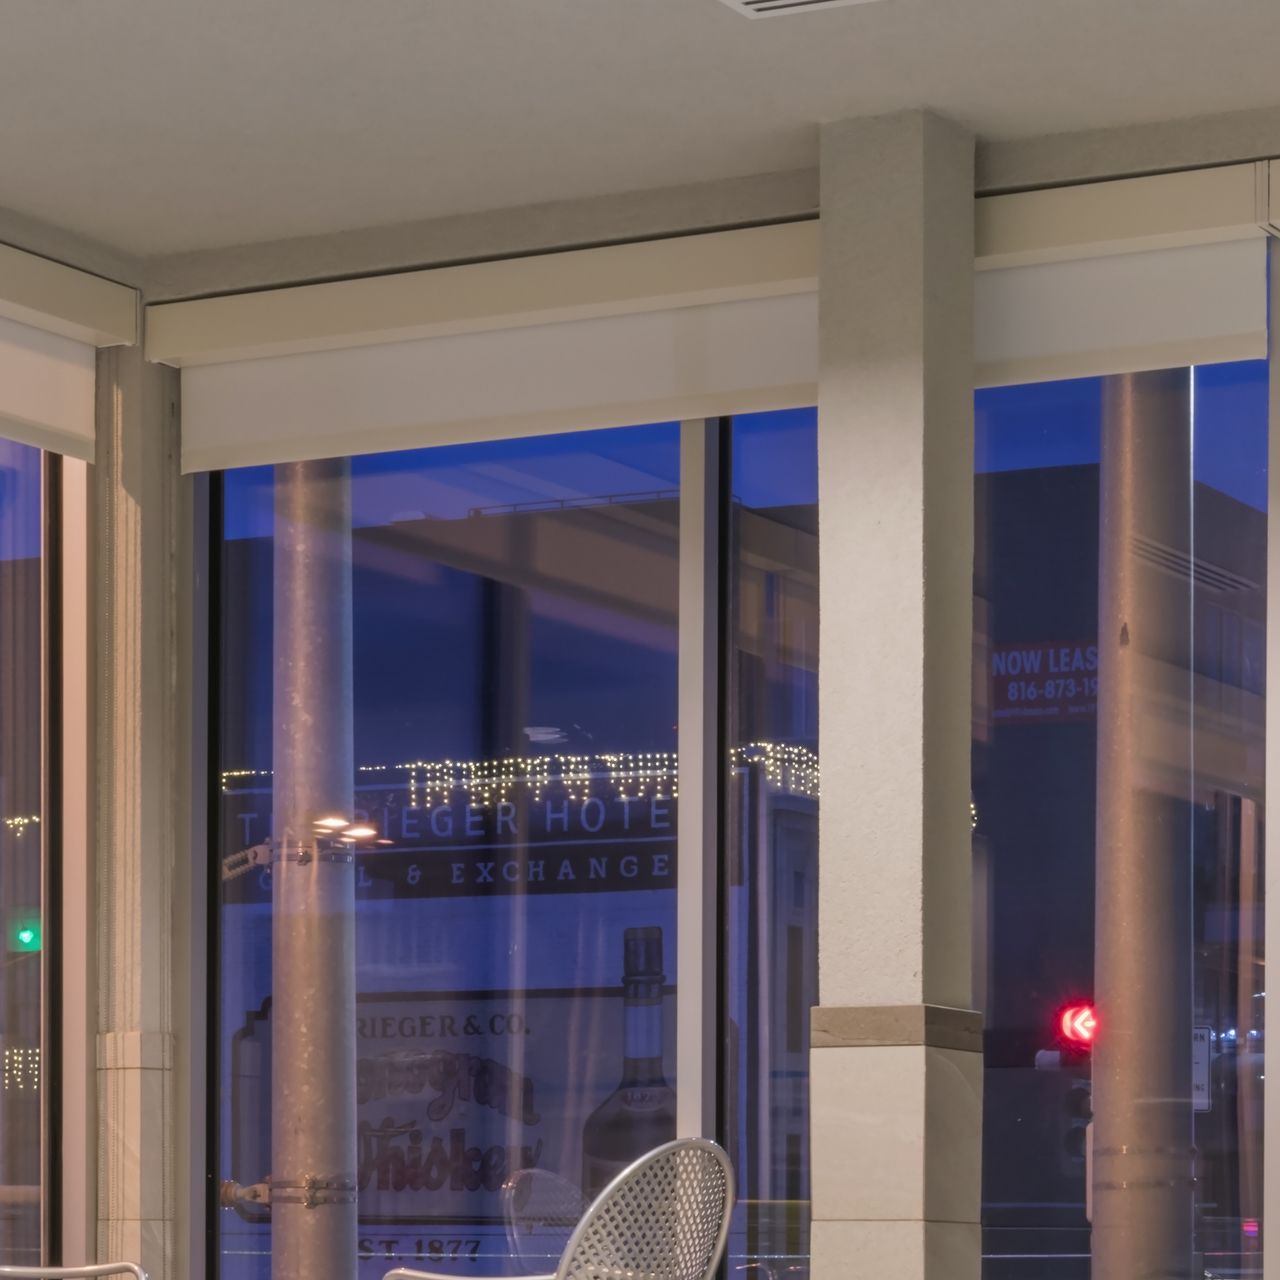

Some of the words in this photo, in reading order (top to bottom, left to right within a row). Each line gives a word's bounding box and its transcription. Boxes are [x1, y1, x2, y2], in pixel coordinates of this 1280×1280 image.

[992, 650, 1042, 676] NOW
[1048, 646, 1097, 673] LEAS
[1007, 677, 1097, 702] 816-873-19
[544, 796, 671, 833] HOTE
[406, 864, 422, 885] &
[450, 854, 670, 884] EXCHANGE
[358, 1239, 403, 1261] ST.
[415, 1240, 481, 1262] 1877
